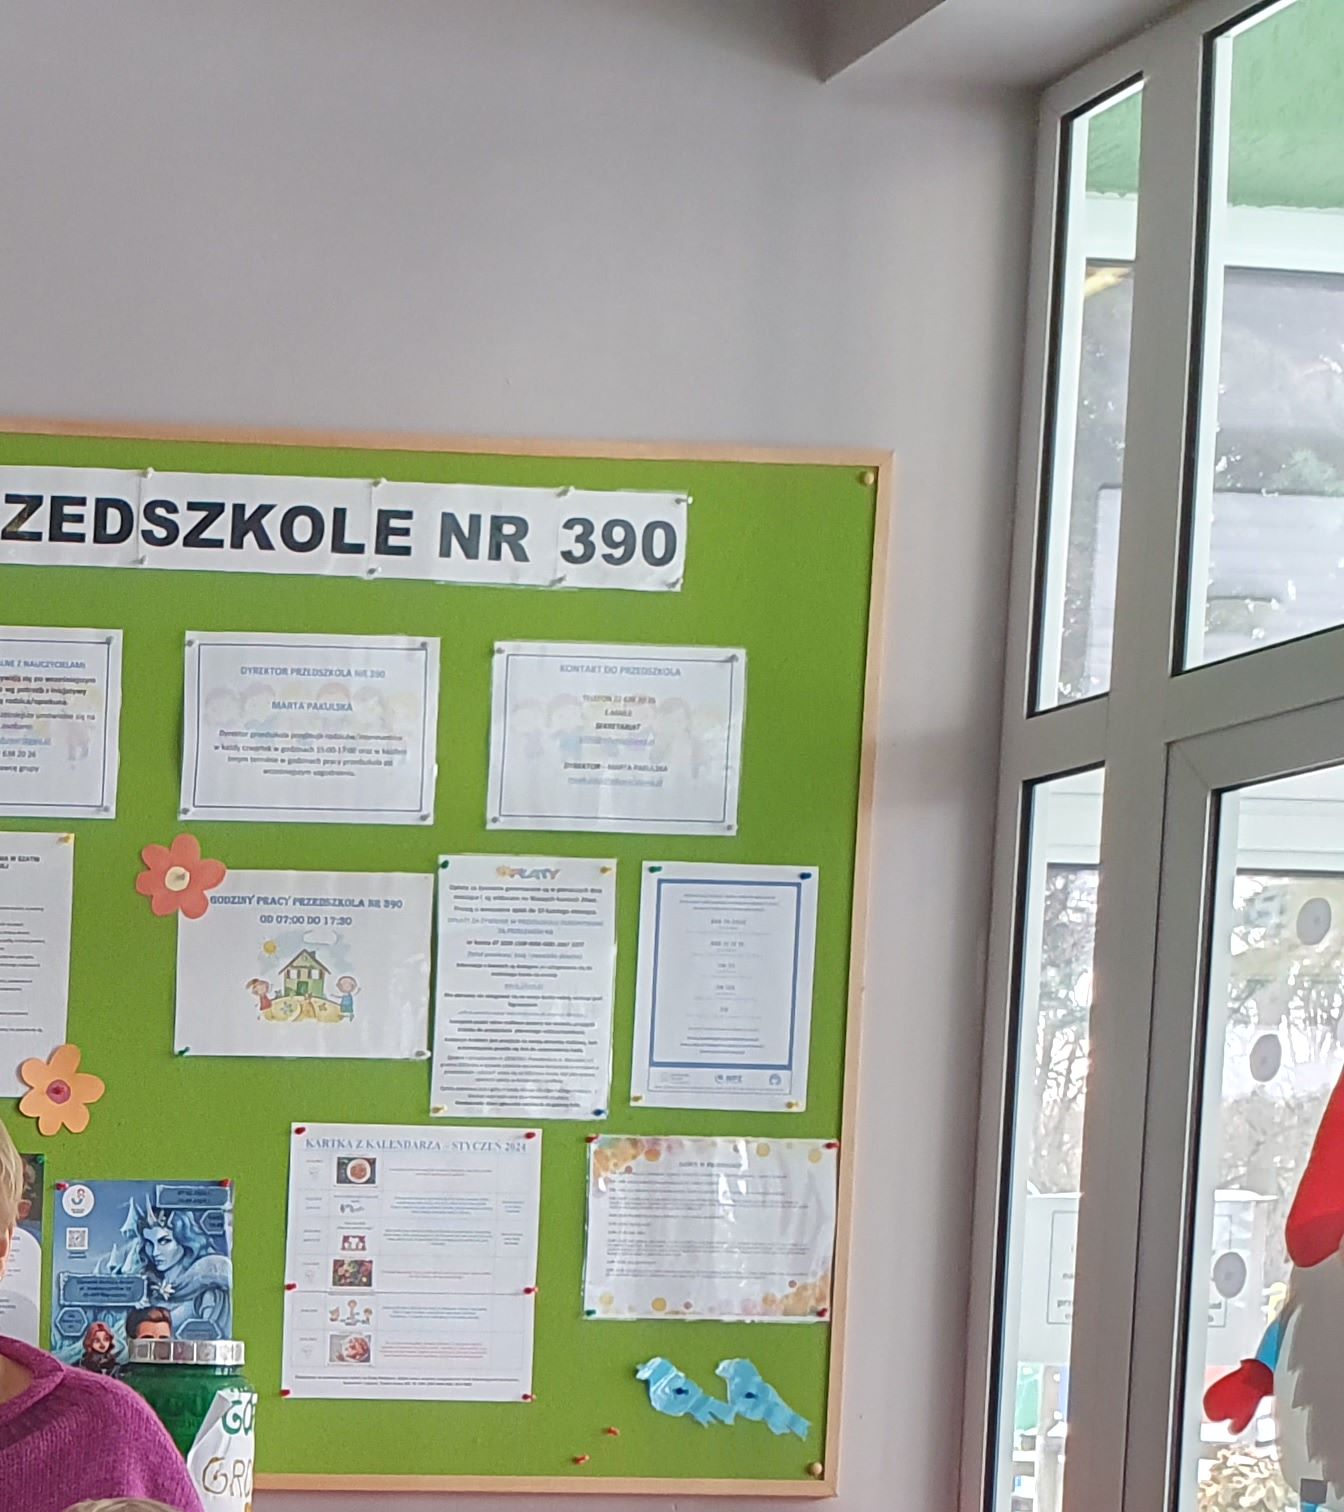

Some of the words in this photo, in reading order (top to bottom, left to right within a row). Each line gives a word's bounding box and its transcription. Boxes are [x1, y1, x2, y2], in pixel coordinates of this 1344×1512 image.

[439, 511, 530, 563] NR
[560, 517, 677, 567] 390
[260, 915, 273, 924] OD
[276, 915, 305, 924] 07:00
[307, 916, 321, 924] DO
[324, 916, 352, 925] 17:30
[306, 1139, 354, 1148] KARTKA
[356, 1140, 362, 1148] Z
[366, 1140, 441, 1150] KALENDARZA
[452, 1140, 502, 1151] STYCZEŃ
